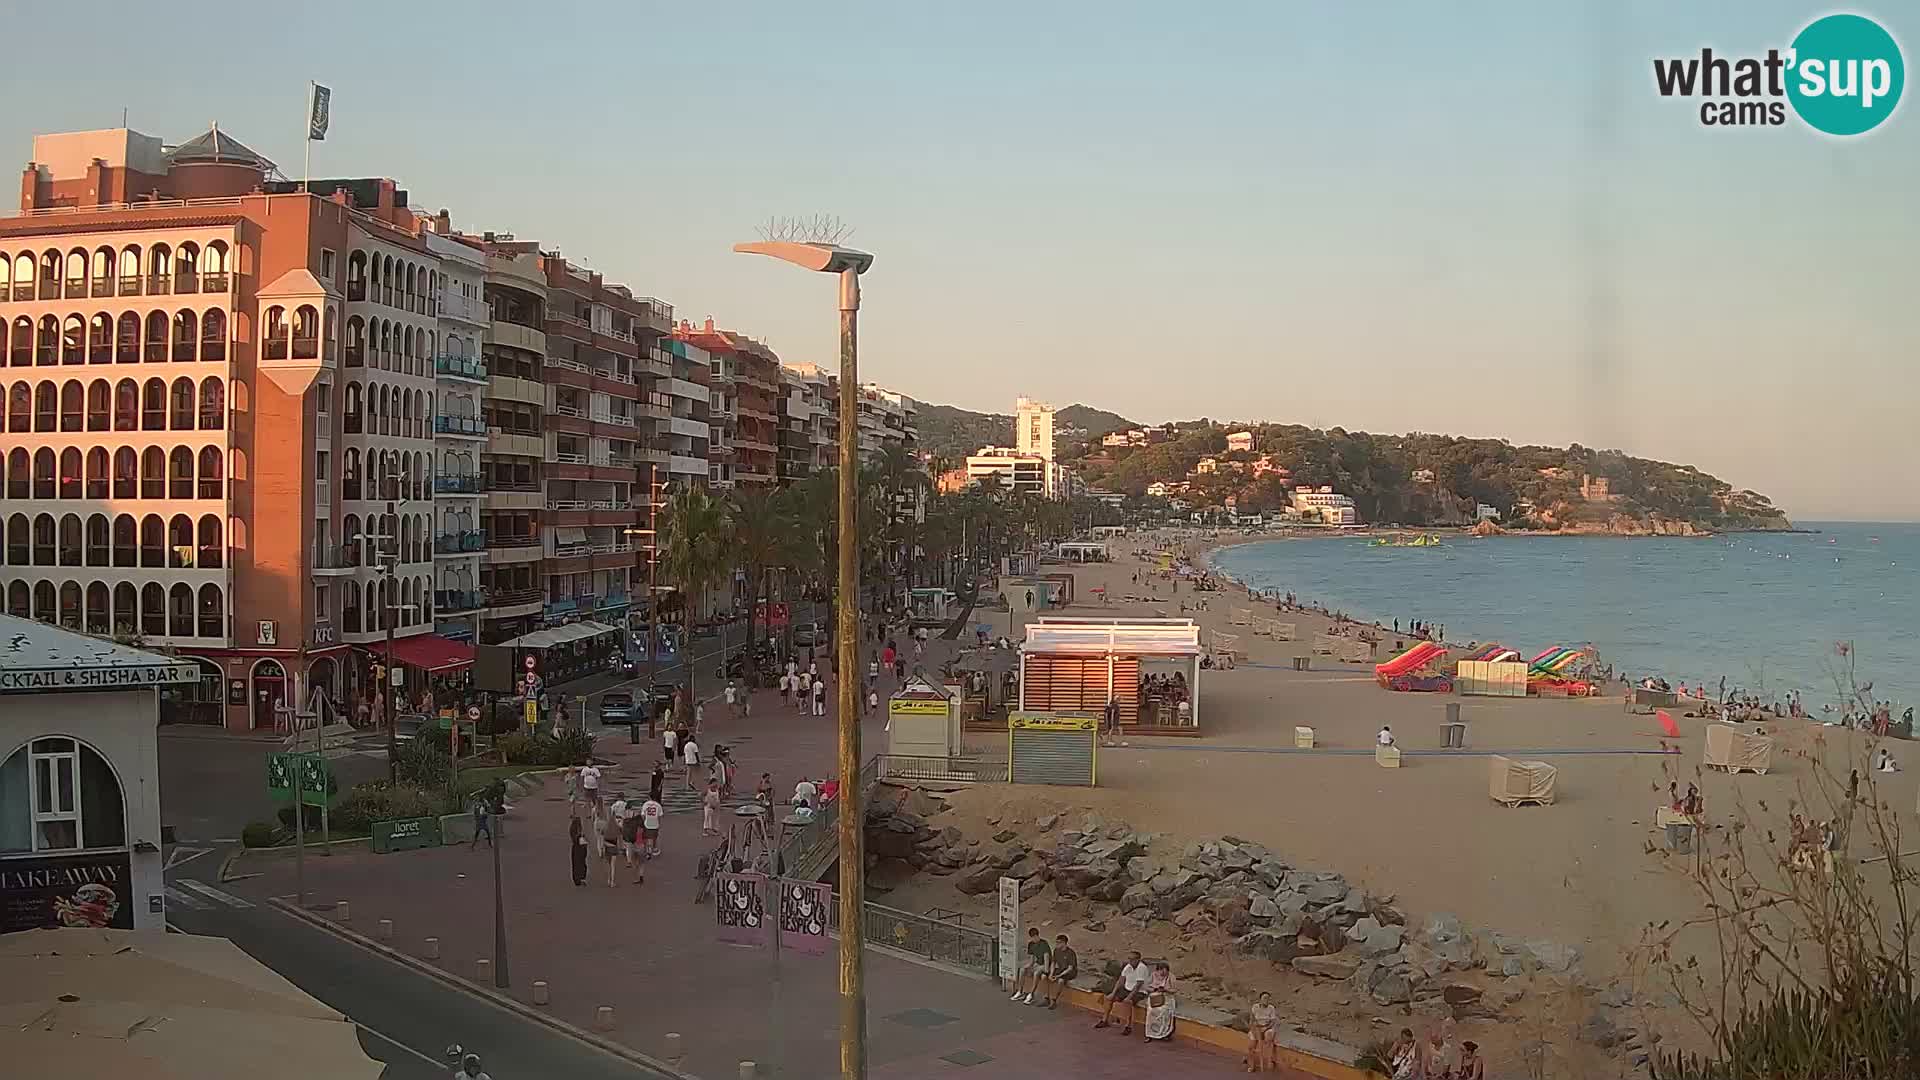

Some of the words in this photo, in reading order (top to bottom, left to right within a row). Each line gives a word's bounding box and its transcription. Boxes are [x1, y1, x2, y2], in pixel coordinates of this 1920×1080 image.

[315, 627, 333, 644] KFC
[64, 671, 75, 685] &
[79, 669, 141, 686] SHISHA
[147, 667, 179, 682] BAR
[394, 820, 420, 833] lloret
